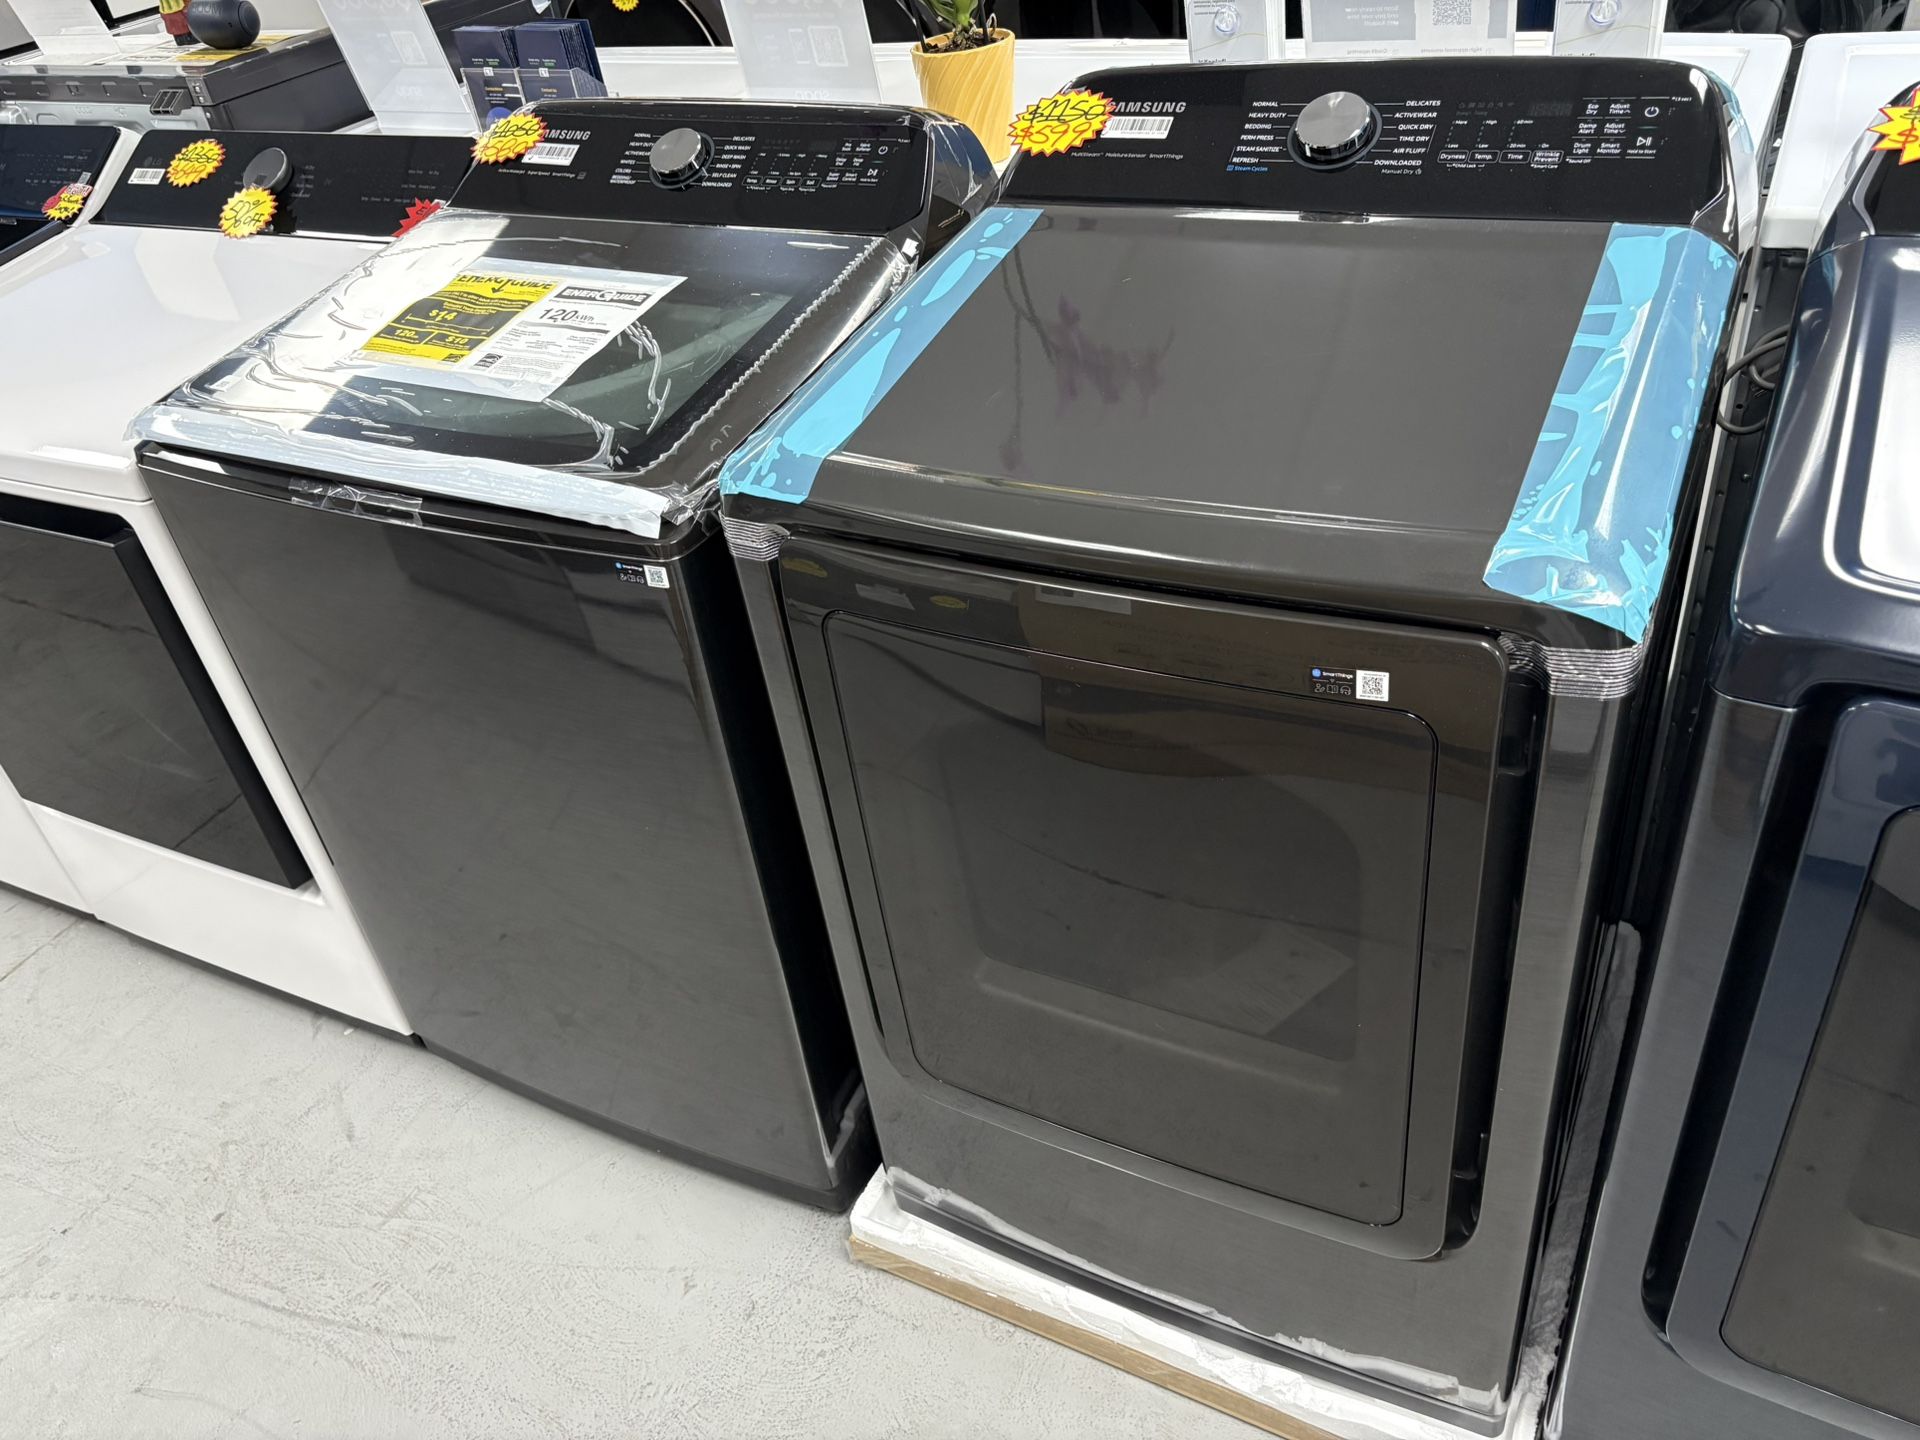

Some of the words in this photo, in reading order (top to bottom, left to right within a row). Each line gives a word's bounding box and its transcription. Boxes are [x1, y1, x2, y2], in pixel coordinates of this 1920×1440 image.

[1014, 122, 1092, 149] $599
[539, 308, 579, 321] 120
[1322, 671, 1353, 679] SmartThings
